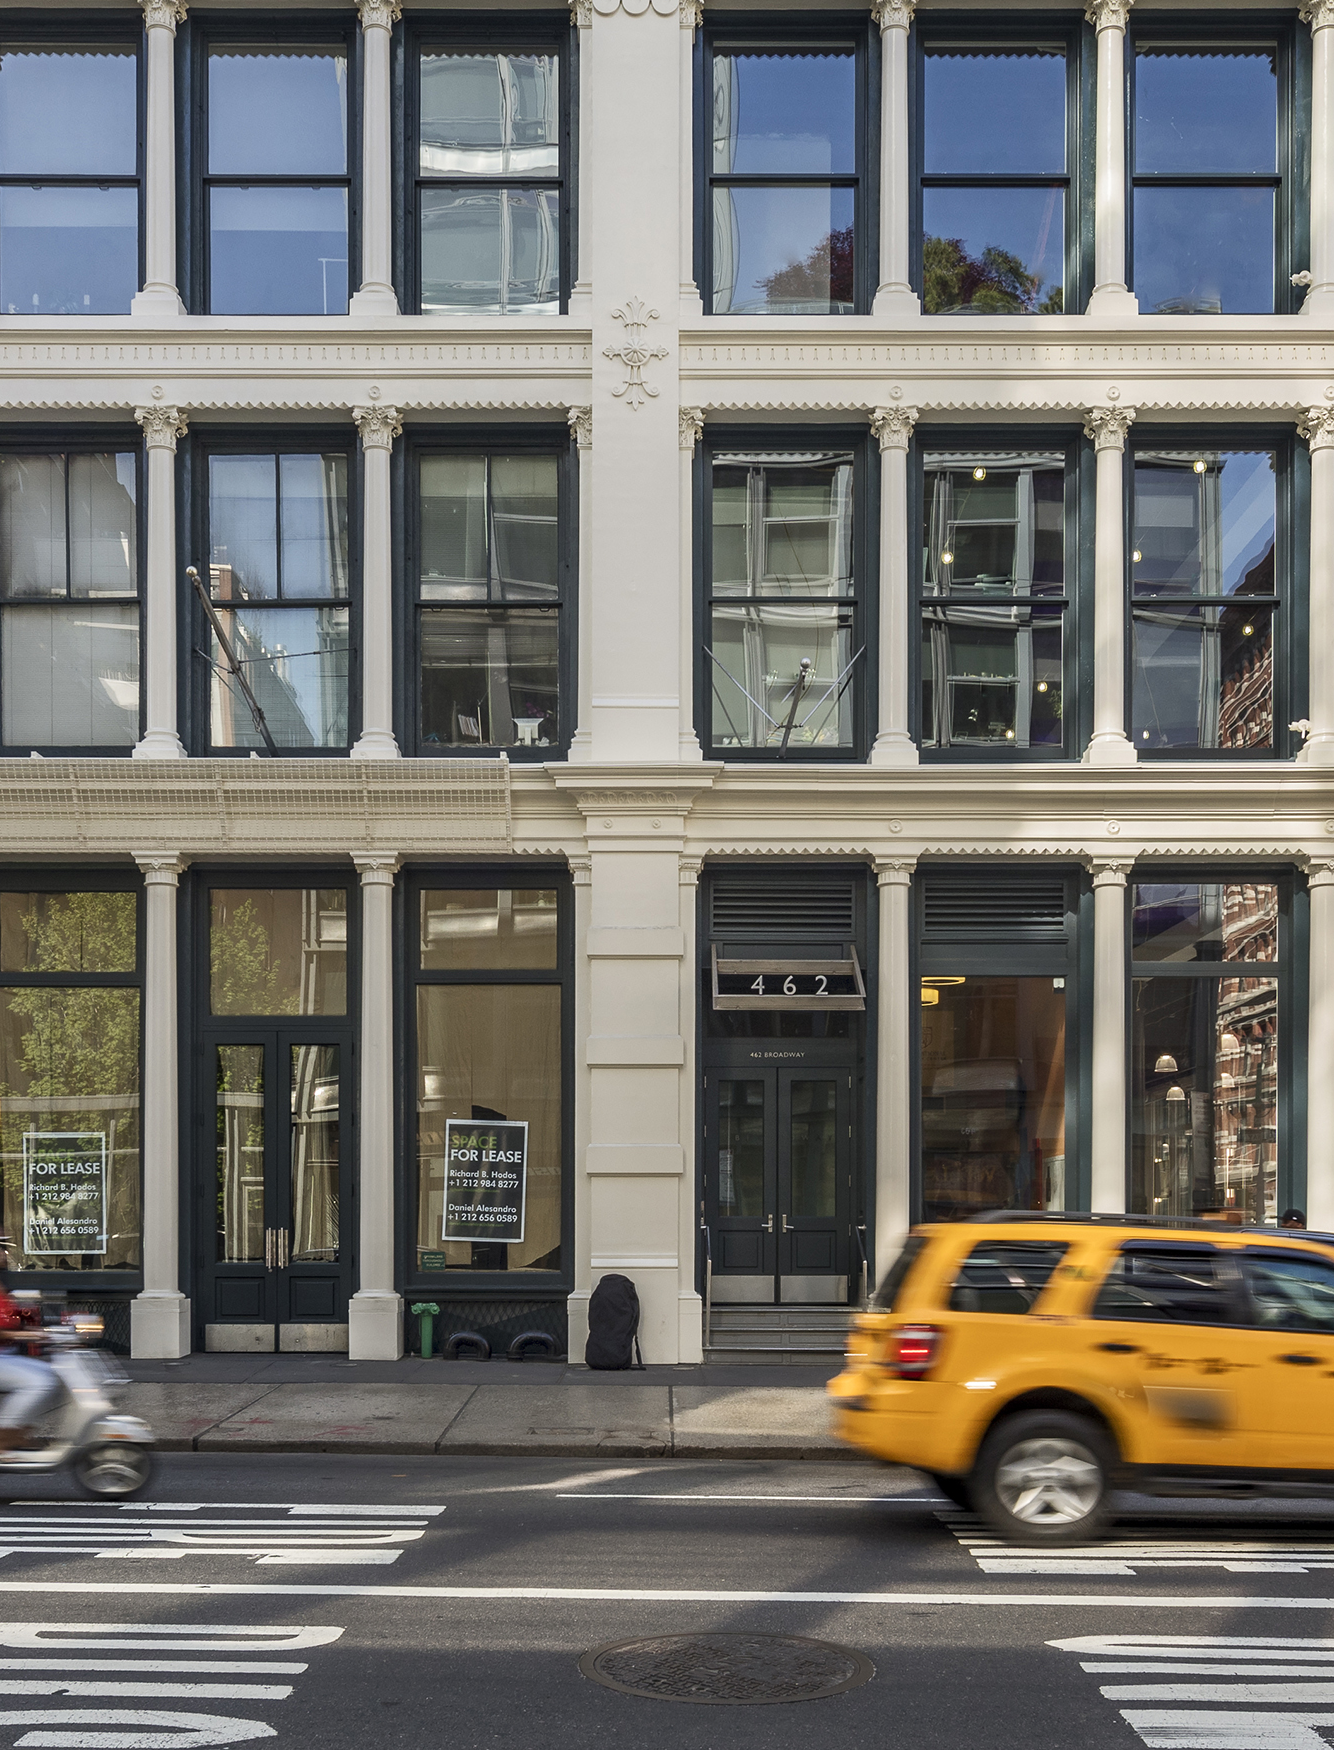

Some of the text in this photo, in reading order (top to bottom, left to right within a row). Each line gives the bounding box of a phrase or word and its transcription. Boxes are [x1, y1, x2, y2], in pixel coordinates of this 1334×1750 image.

[750, 975, 828, 995] 462
[452, 1135, 497, 1149] SPACE
[450, 1150, 522, 1162] FOR LEASE
[29, 1163, 100, 1174] FOR LEASE
[449, 1170, 479, 1178] Richard
[476, 1204, 516, 1213] Alesandro
[496, 1214, 517, 1222] 0589
